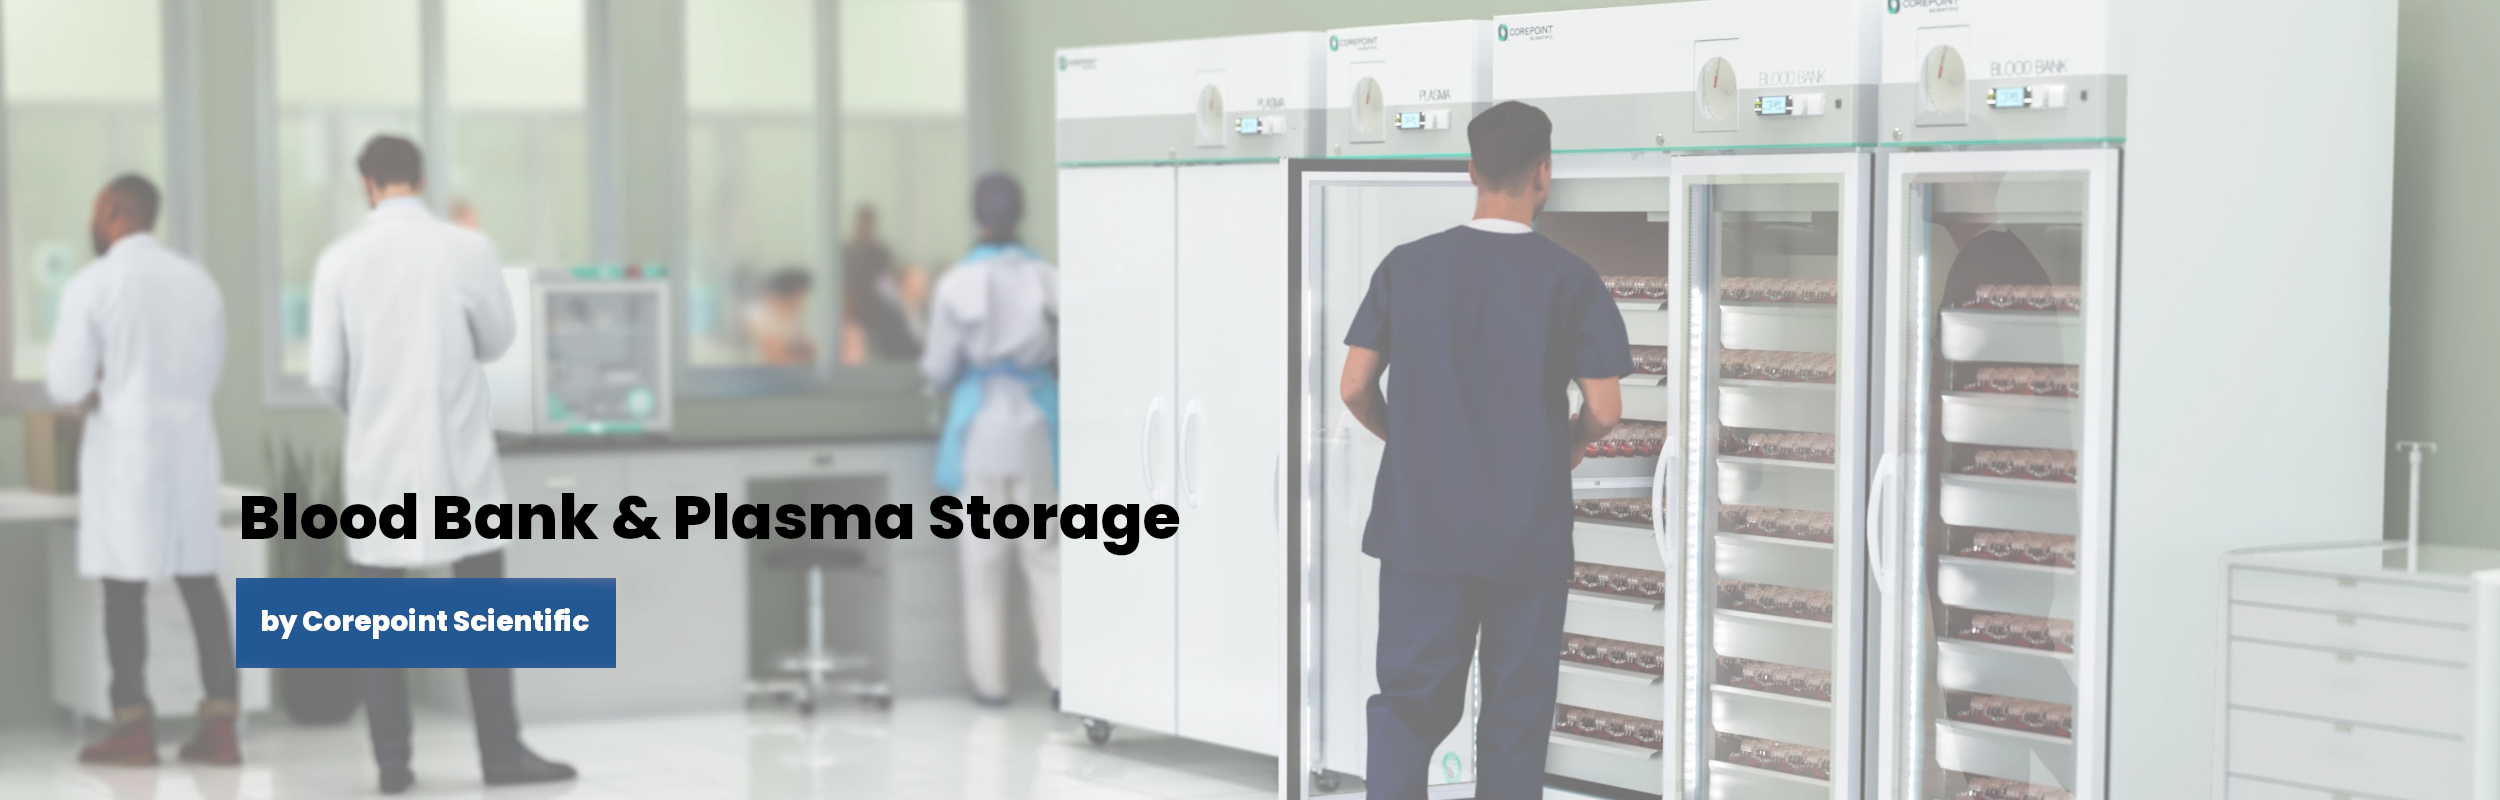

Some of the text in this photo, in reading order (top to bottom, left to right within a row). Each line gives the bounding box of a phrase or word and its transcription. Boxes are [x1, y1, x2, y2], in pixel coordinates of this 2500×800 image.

[1509, 25, 1554, 36] COREPOINT
[1339, 36, 1378, 47] COREPOINT
[1990, 59, 2069, 76] BLOOD BANK
[1759, 69, 1827, 86] BLOOD BANK
[1419, 88, 1452, 102] PLASMA
